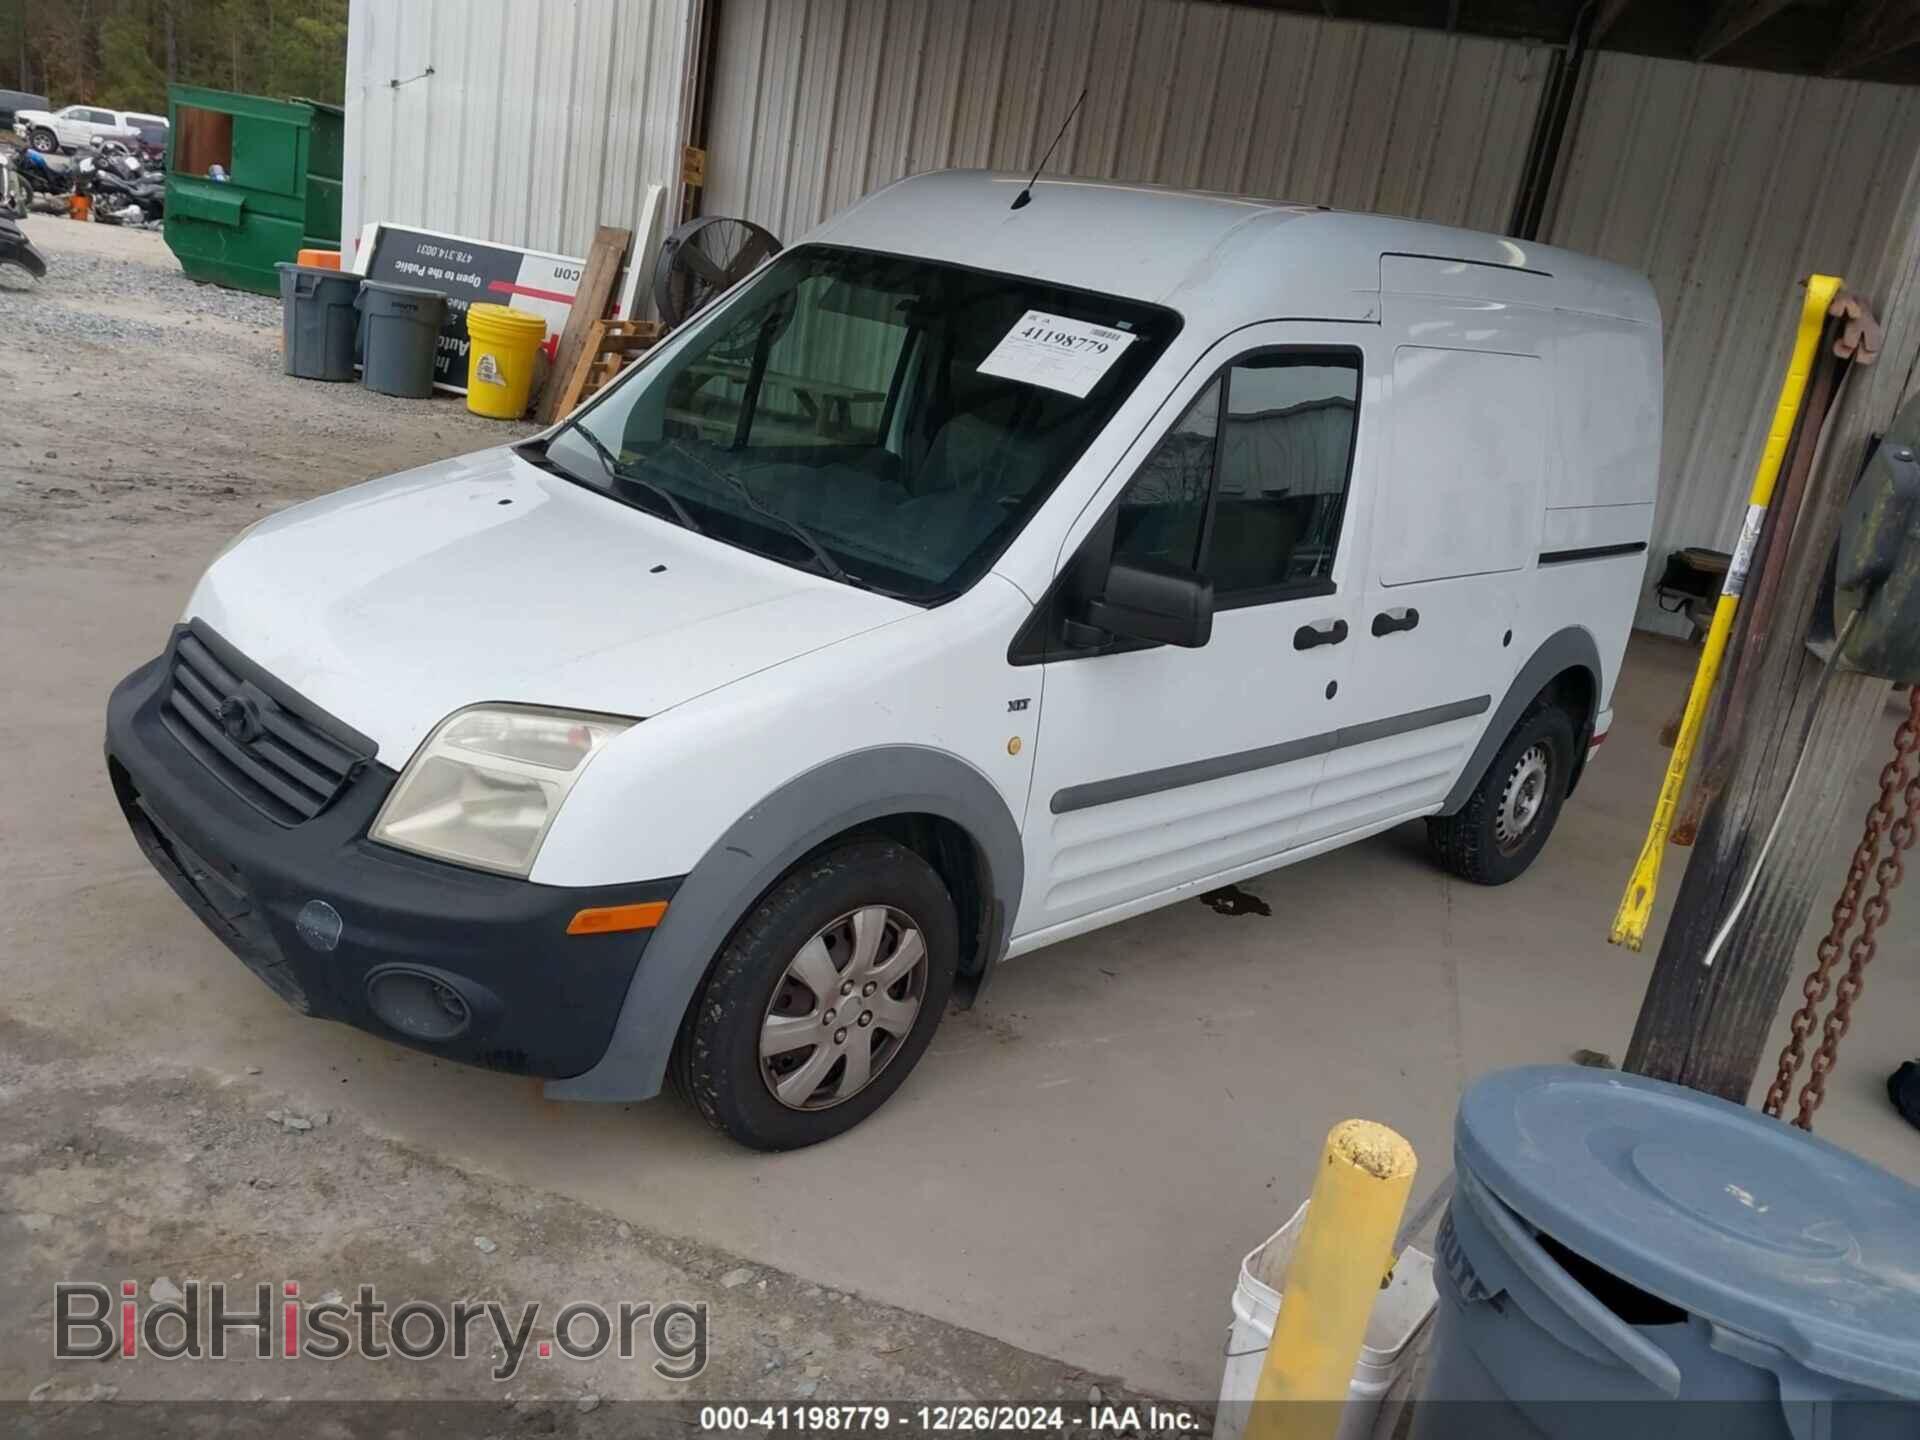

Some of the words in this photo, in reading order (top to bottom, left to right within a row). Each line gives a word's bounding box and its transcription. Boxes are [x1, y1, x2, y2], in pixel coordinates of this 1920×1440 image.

[394, 260, 426, 277] Public
[427, 267, 443, 280] the
[444, 270, 455, 281] to
[553, 266, 581, 282] con
[456, 273, 482, 288] Open
[1021, 326, 1109, 355] 41198779
[1007, 698, 1031, 712] XLT
